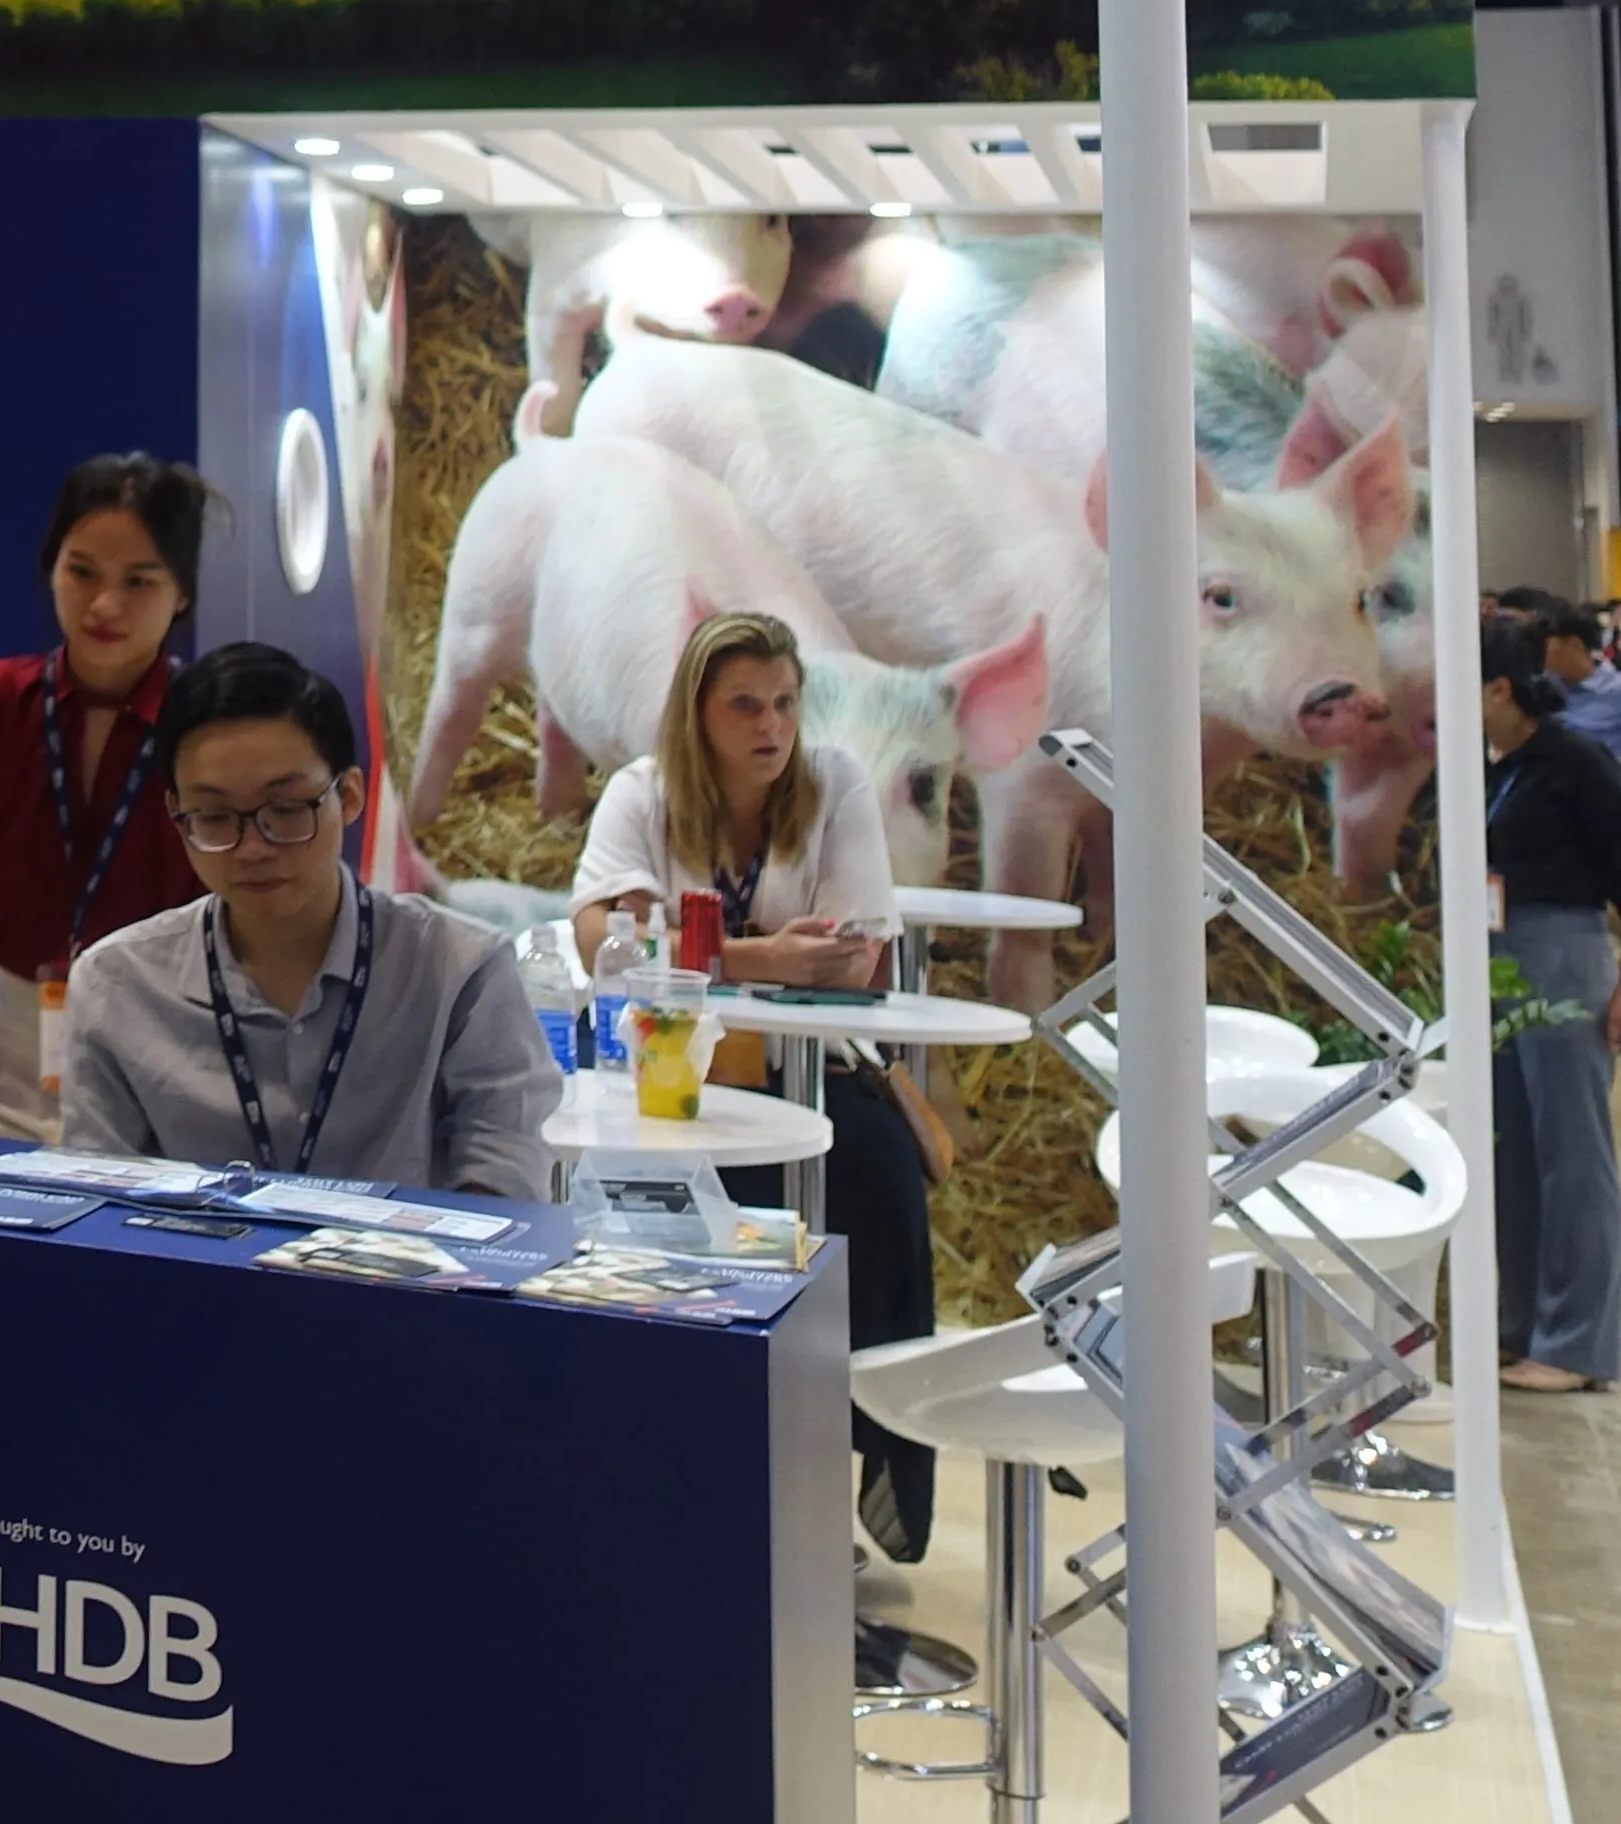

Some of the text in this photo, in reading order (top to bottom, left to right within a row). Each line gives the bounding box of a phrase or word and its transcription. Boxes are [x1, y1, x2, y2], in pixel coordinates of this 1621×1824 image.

[49, 1526, 72, 1546] to
[77, 1533, 115, 1555] you
[120, 1534, 146, 1565] by
